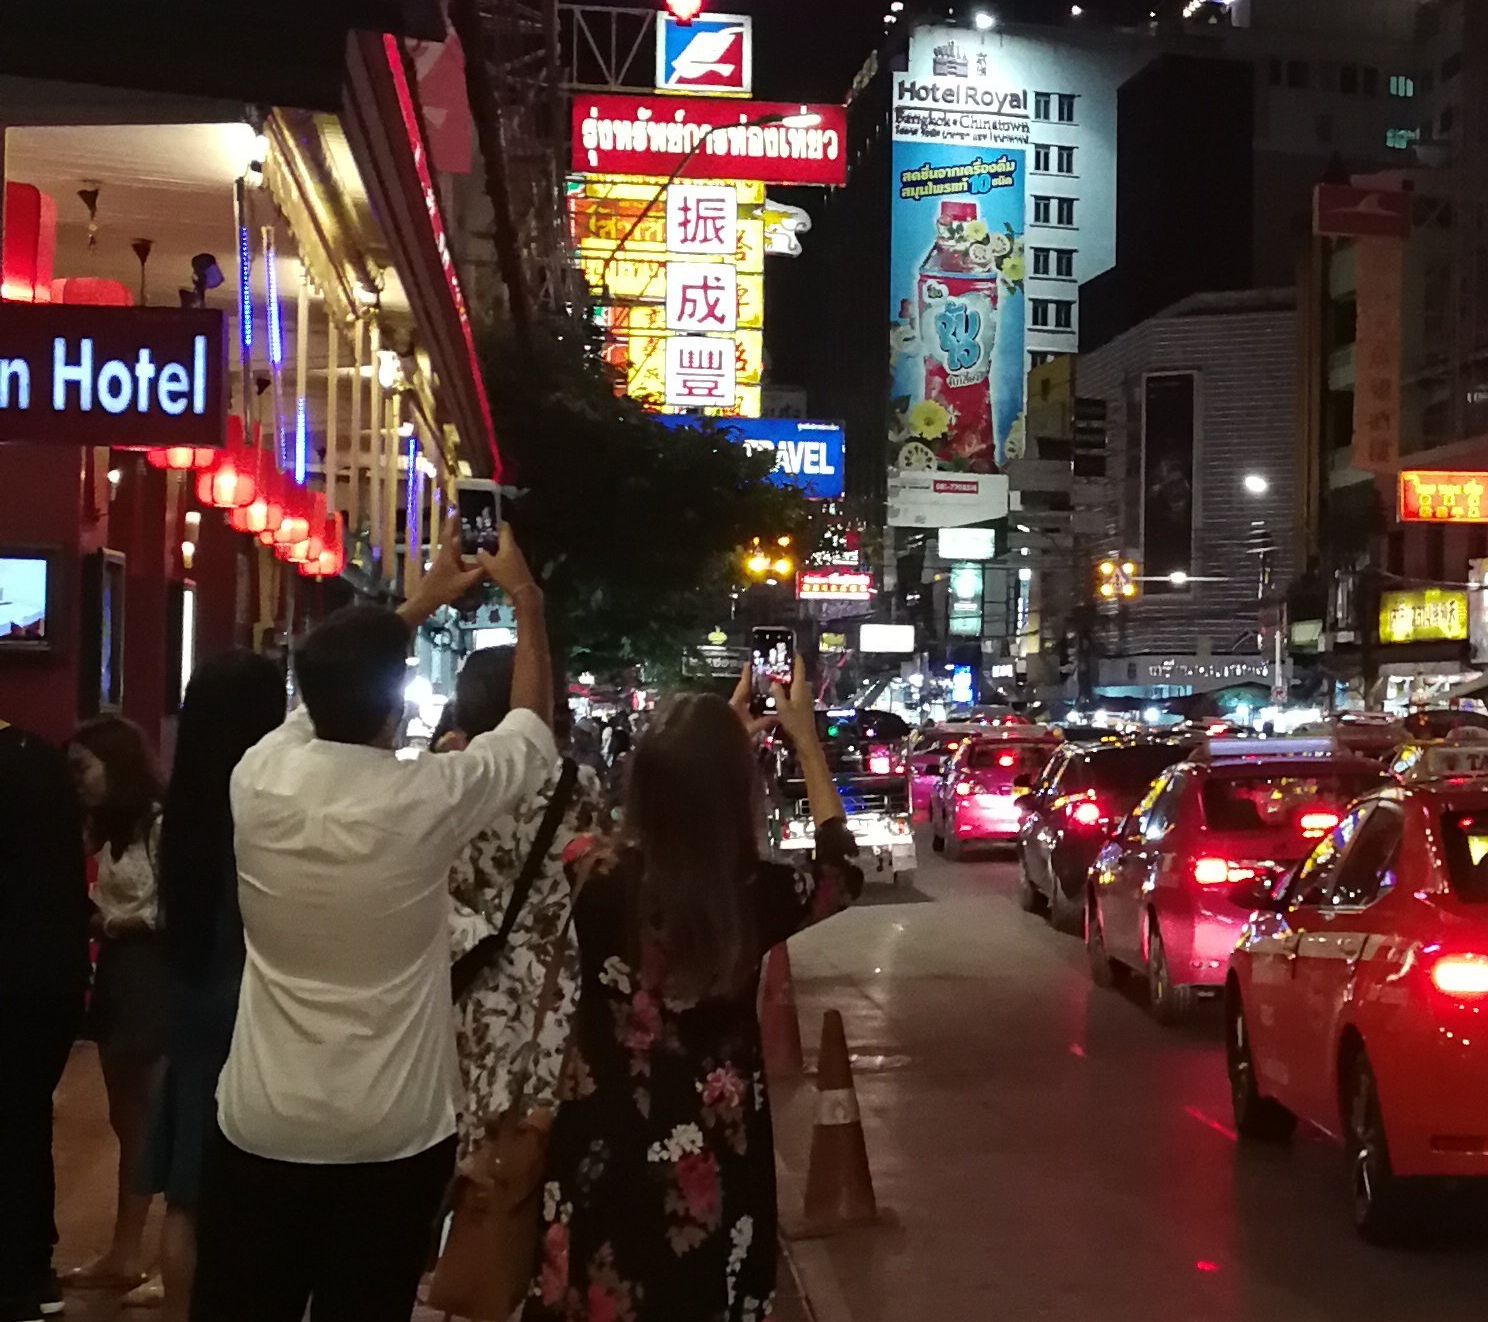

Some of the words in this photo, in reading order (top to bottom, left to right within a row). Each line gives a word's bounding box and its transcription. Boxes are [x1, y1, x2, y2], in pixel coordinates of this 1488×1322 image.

[897, 79, 961, 105] Hotel
[965, 86, 1028, 113] Royal
[968, 175, 992, 194] 10
[52, 334, 208, 416] Hotel
